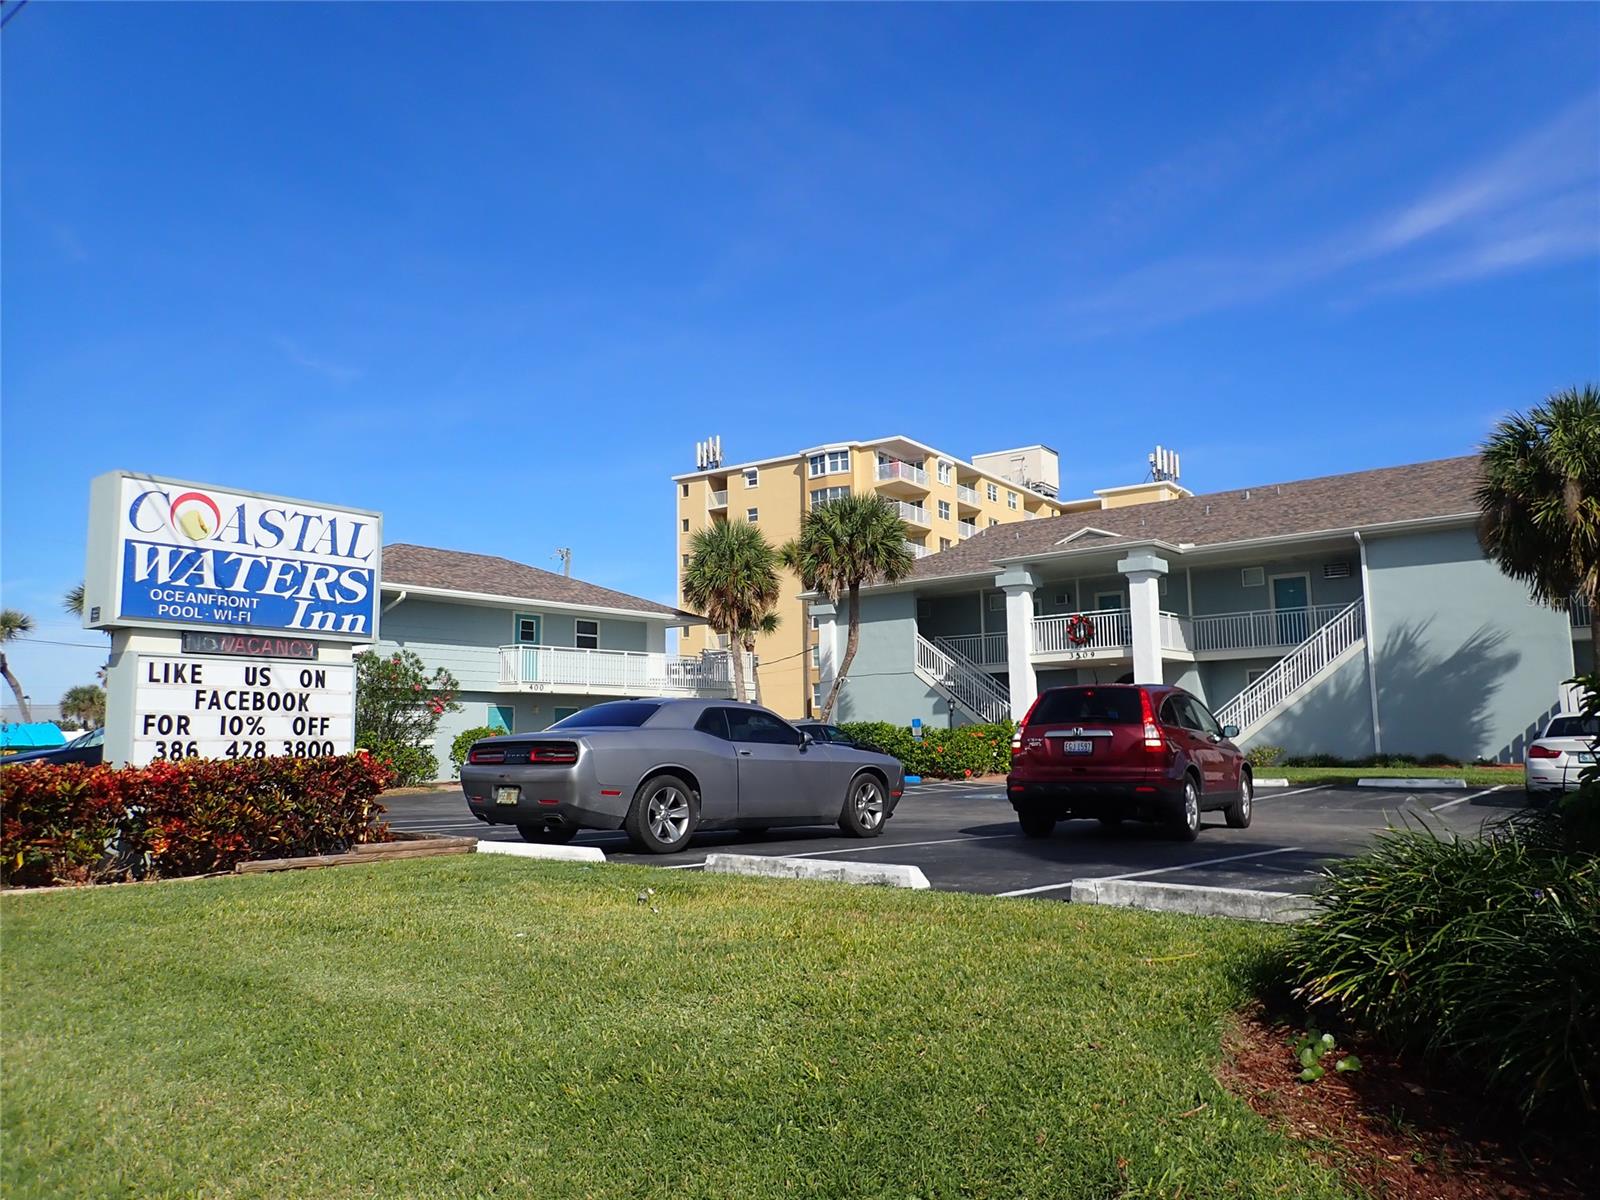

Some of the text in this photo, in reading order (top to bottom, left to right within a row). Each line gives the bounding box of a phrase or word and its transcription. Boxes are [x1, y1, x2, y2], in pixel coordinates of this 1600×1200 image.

[129, 490, 374, 563] COASTAL
[131, 542, 370, 604] WATERS
[149, 588, 260, 609] OCEANFRONT
[213, 608, 251, 622] WI-FI
[285, 599, 367, 634] Inn
[220, 636, 314, 657] VACANCY
[148, 661, 326, 689] LIKE US ON
[529, 683, 545, 691] 400
[194, 689, 310, 712] FACEBOOK
[143, 714, 330, 737] FOR 10% OFF
[154, 740, 335, 761] 386 428 3800
